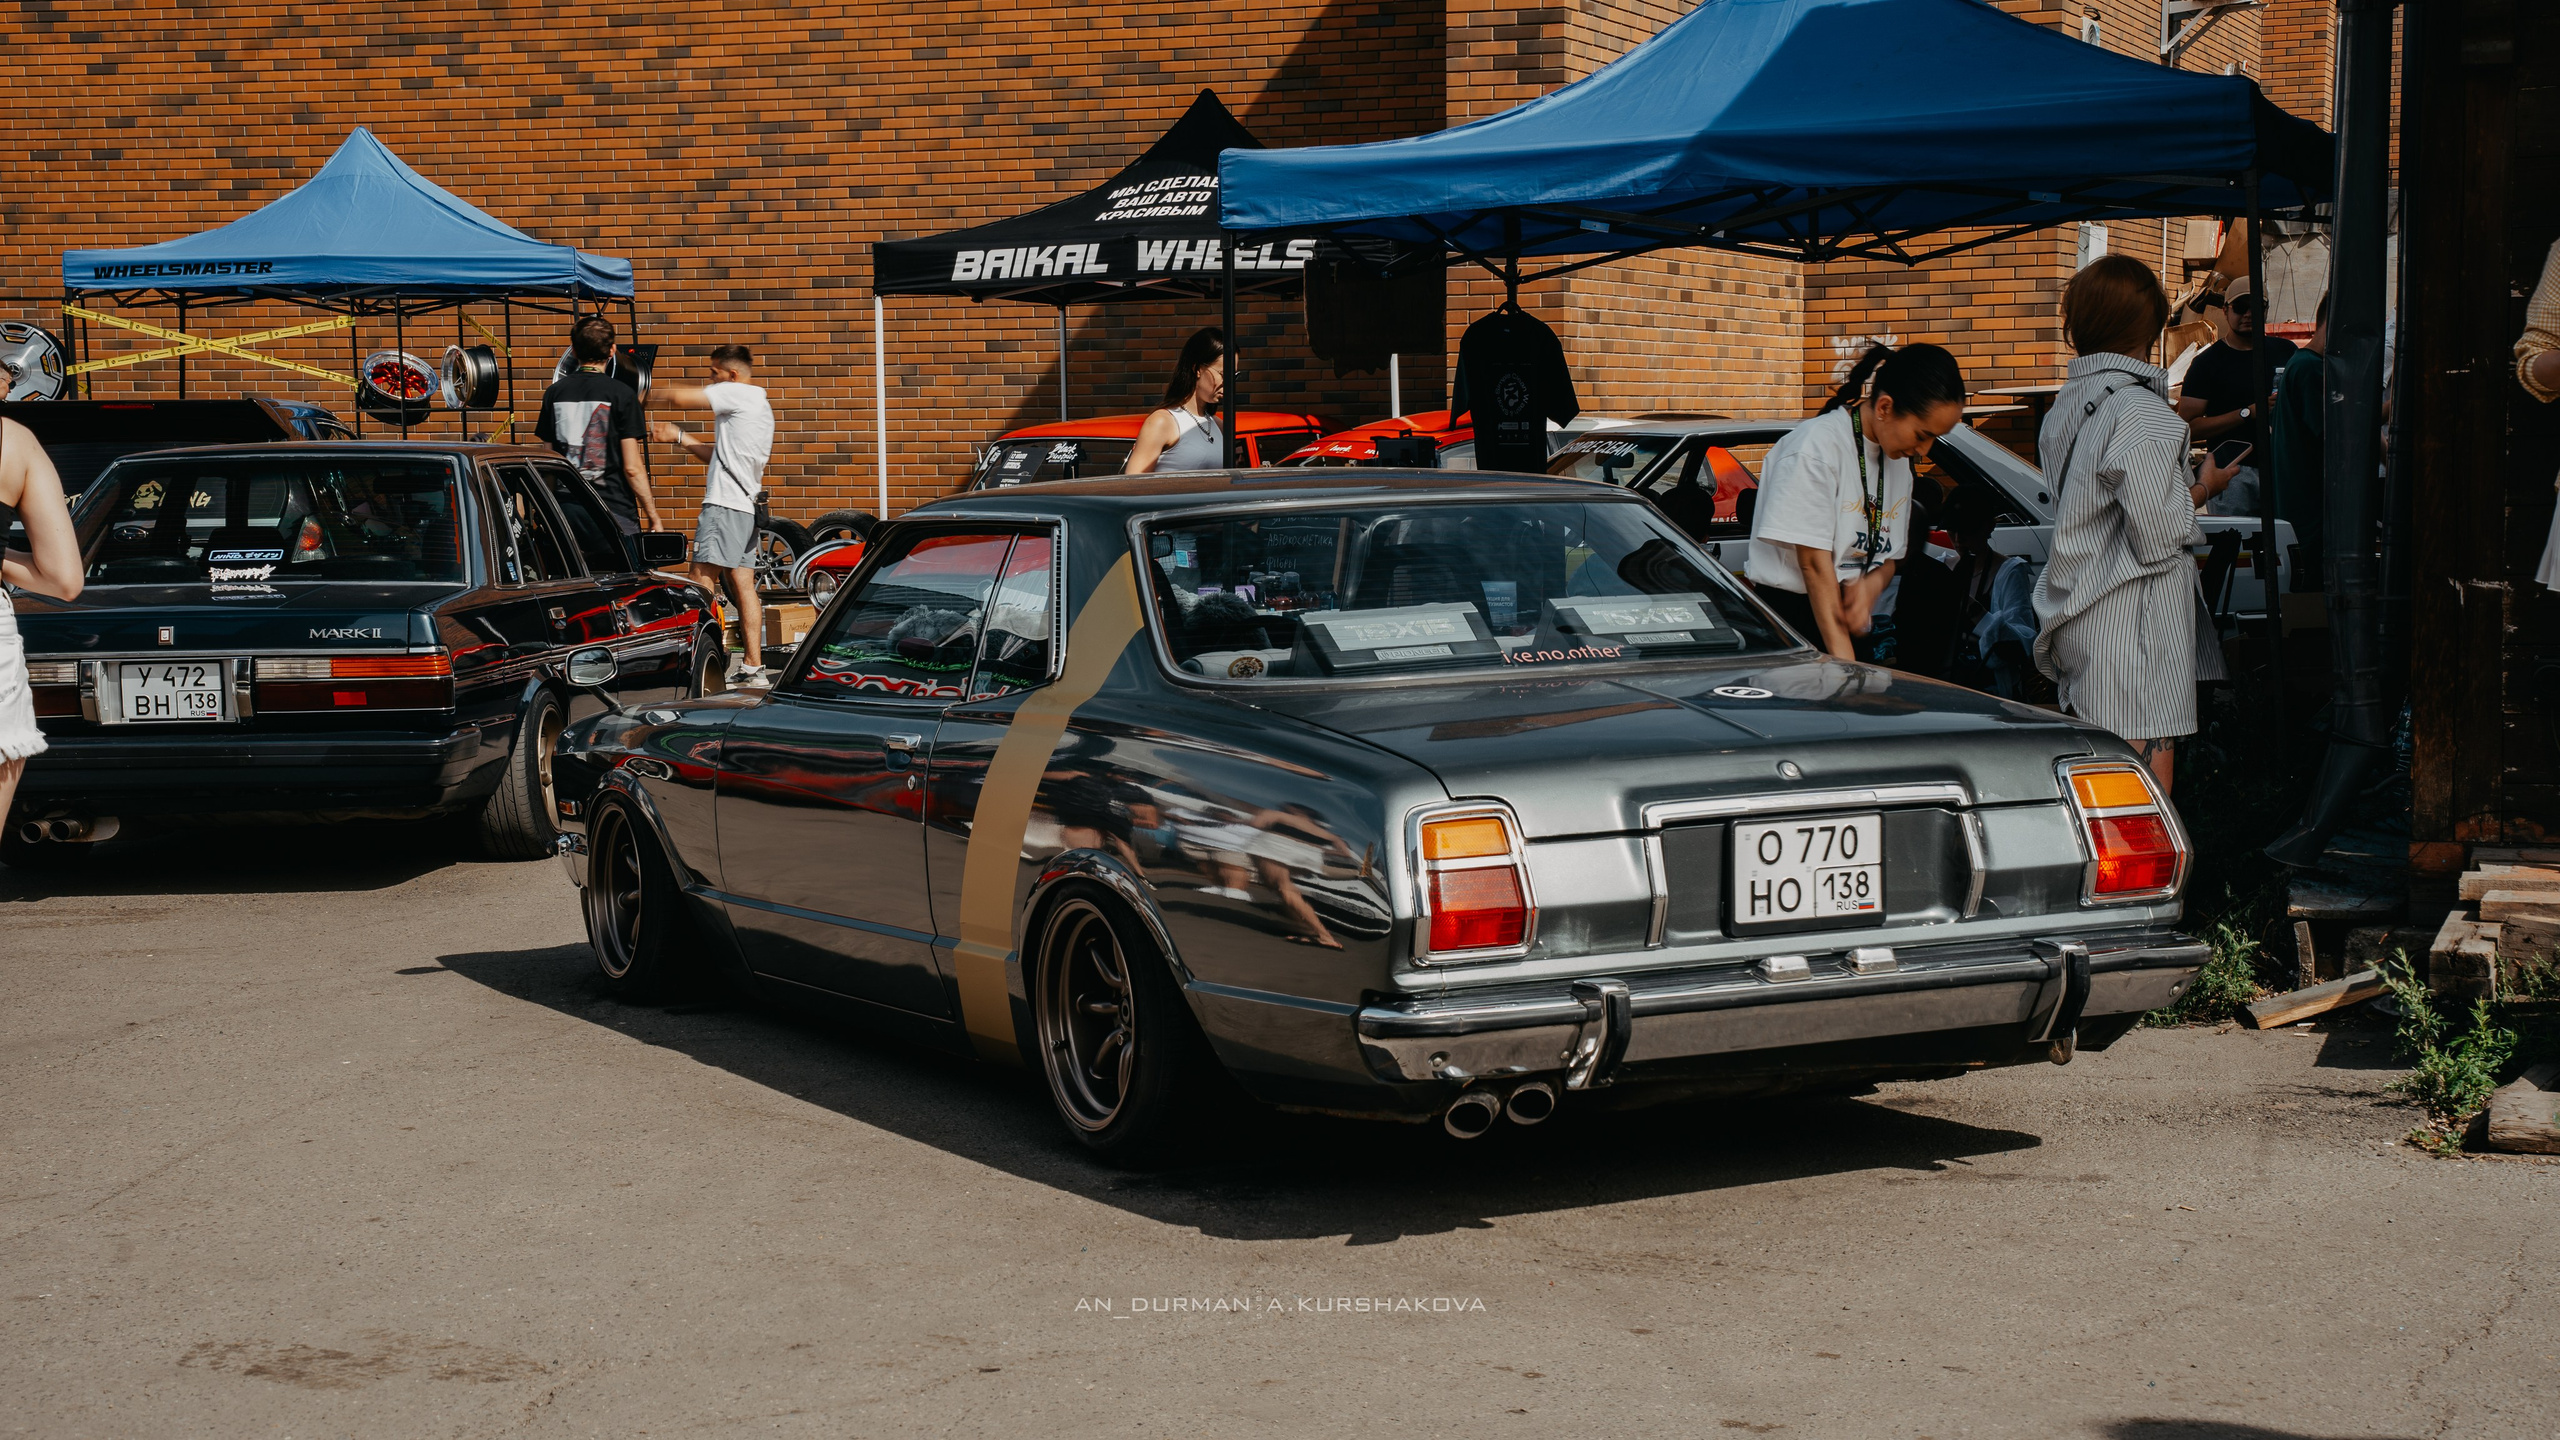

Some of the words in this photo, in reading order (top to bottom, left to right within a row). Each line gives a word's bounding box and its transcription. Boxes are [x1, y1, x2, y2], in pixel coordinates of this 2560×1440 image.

[1107, 183, 1145, 200] МЫ
[1144, 176, 1219, 192] СДЕЛАЕ
[1113, 193, 1160, 209] ВАШ
[1158, 191, 1212, 204] АВТО
[1095, 205, 1208, 222] КРАСИВЫМ
[951, 243, 1109, 282] BAIKAL
[1137, 239, 1317, 271] WHEELS
[93, 261, 273, 280] WHEELSMASTER
[1593, 440, 1639, 458] CLEAN
[309, 627, 370, 639] MARK
[372, 627, 382, 639] II
[1390, 648, 1446, 659] PIONEER
[163, 666, 206, 687] 472
[183, 693, 217, 709] 138
[1796, 824, 1858, 864] 770
[1822, 870, 1870, 901] 138
[1836, 900, 1858, 911] RUS
